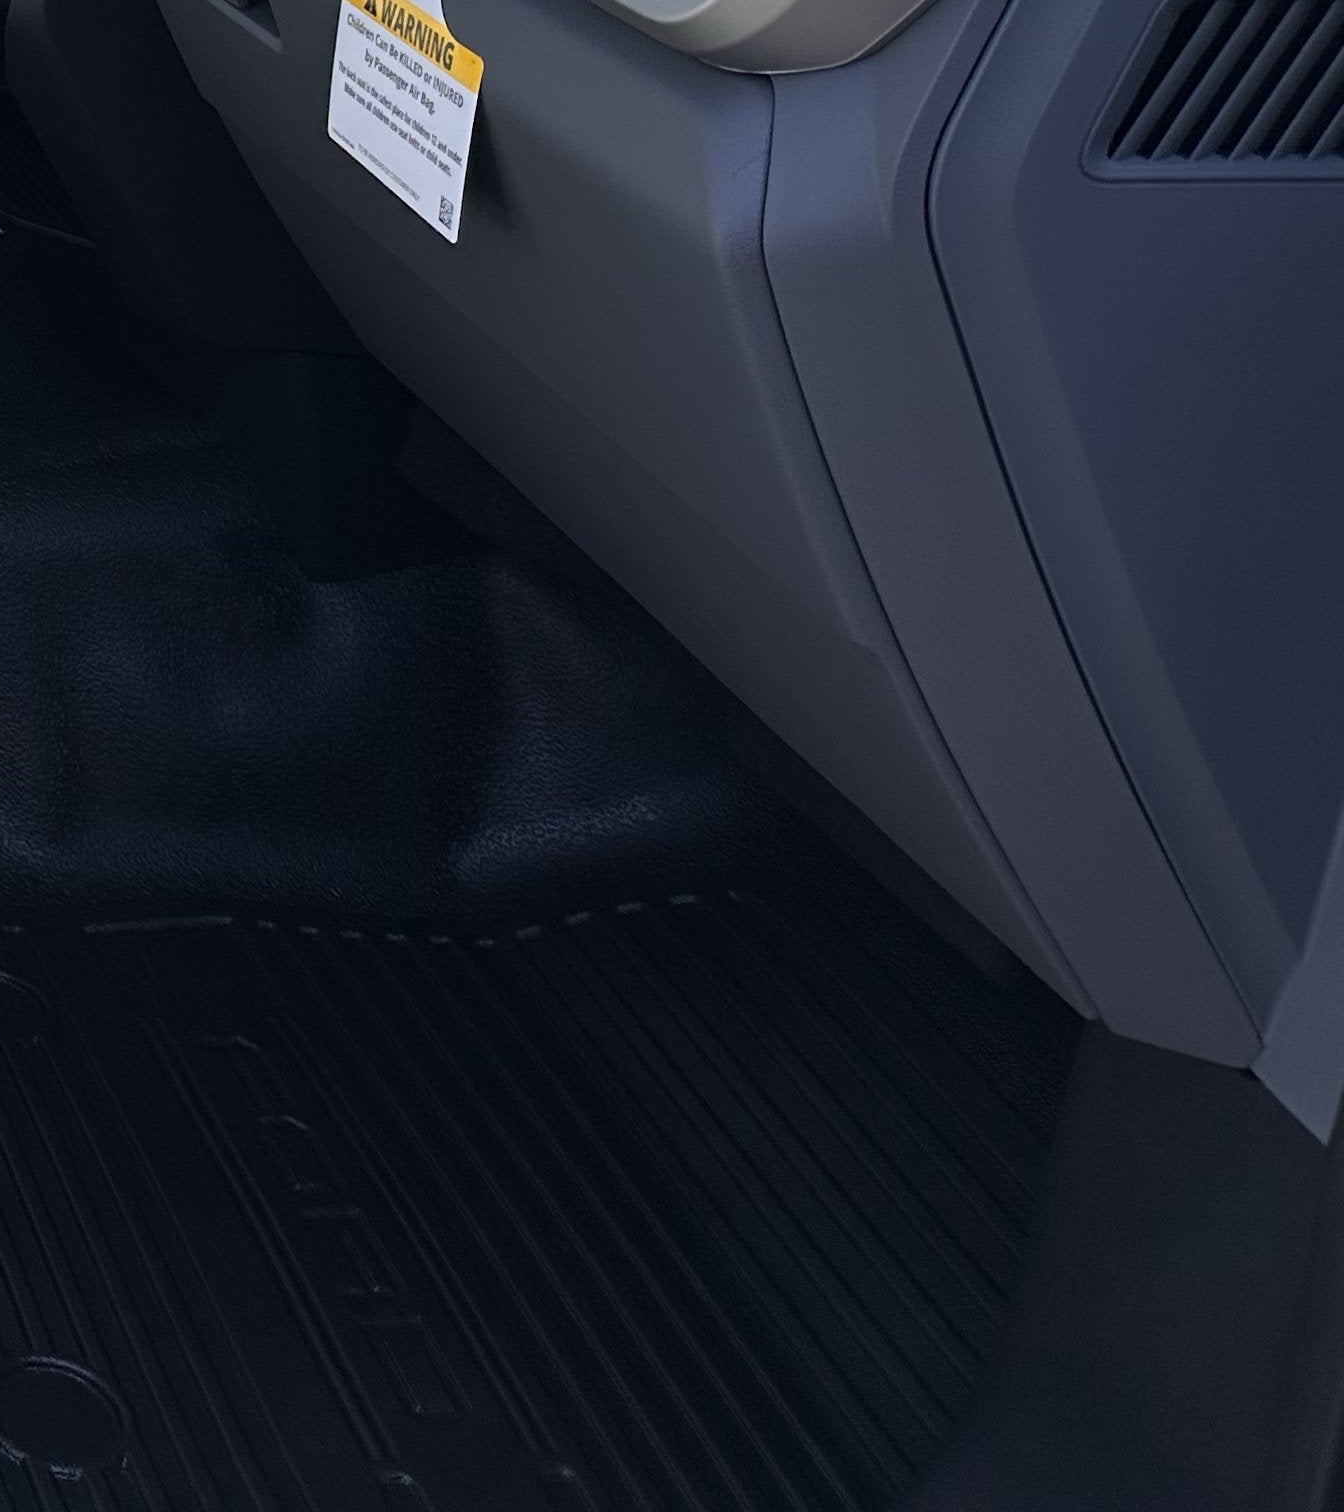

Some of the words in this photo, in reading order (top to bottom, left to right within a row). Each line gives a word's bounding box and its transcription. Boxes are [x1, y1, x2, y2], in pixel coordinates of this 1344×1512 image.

[347, 13, 374, 42] Children
[375, 35, 388, 52] Can
[389, 43, 398, 60] Be
[399, 51, 423, 78] KILLED
[424, 71, 432, 84] or
[433, 77, 464, 108] INJURED
[364, 48, 374, 68] by
[374, 56, 409, 90] Passenger
[409, 84, 420, 100] Air
